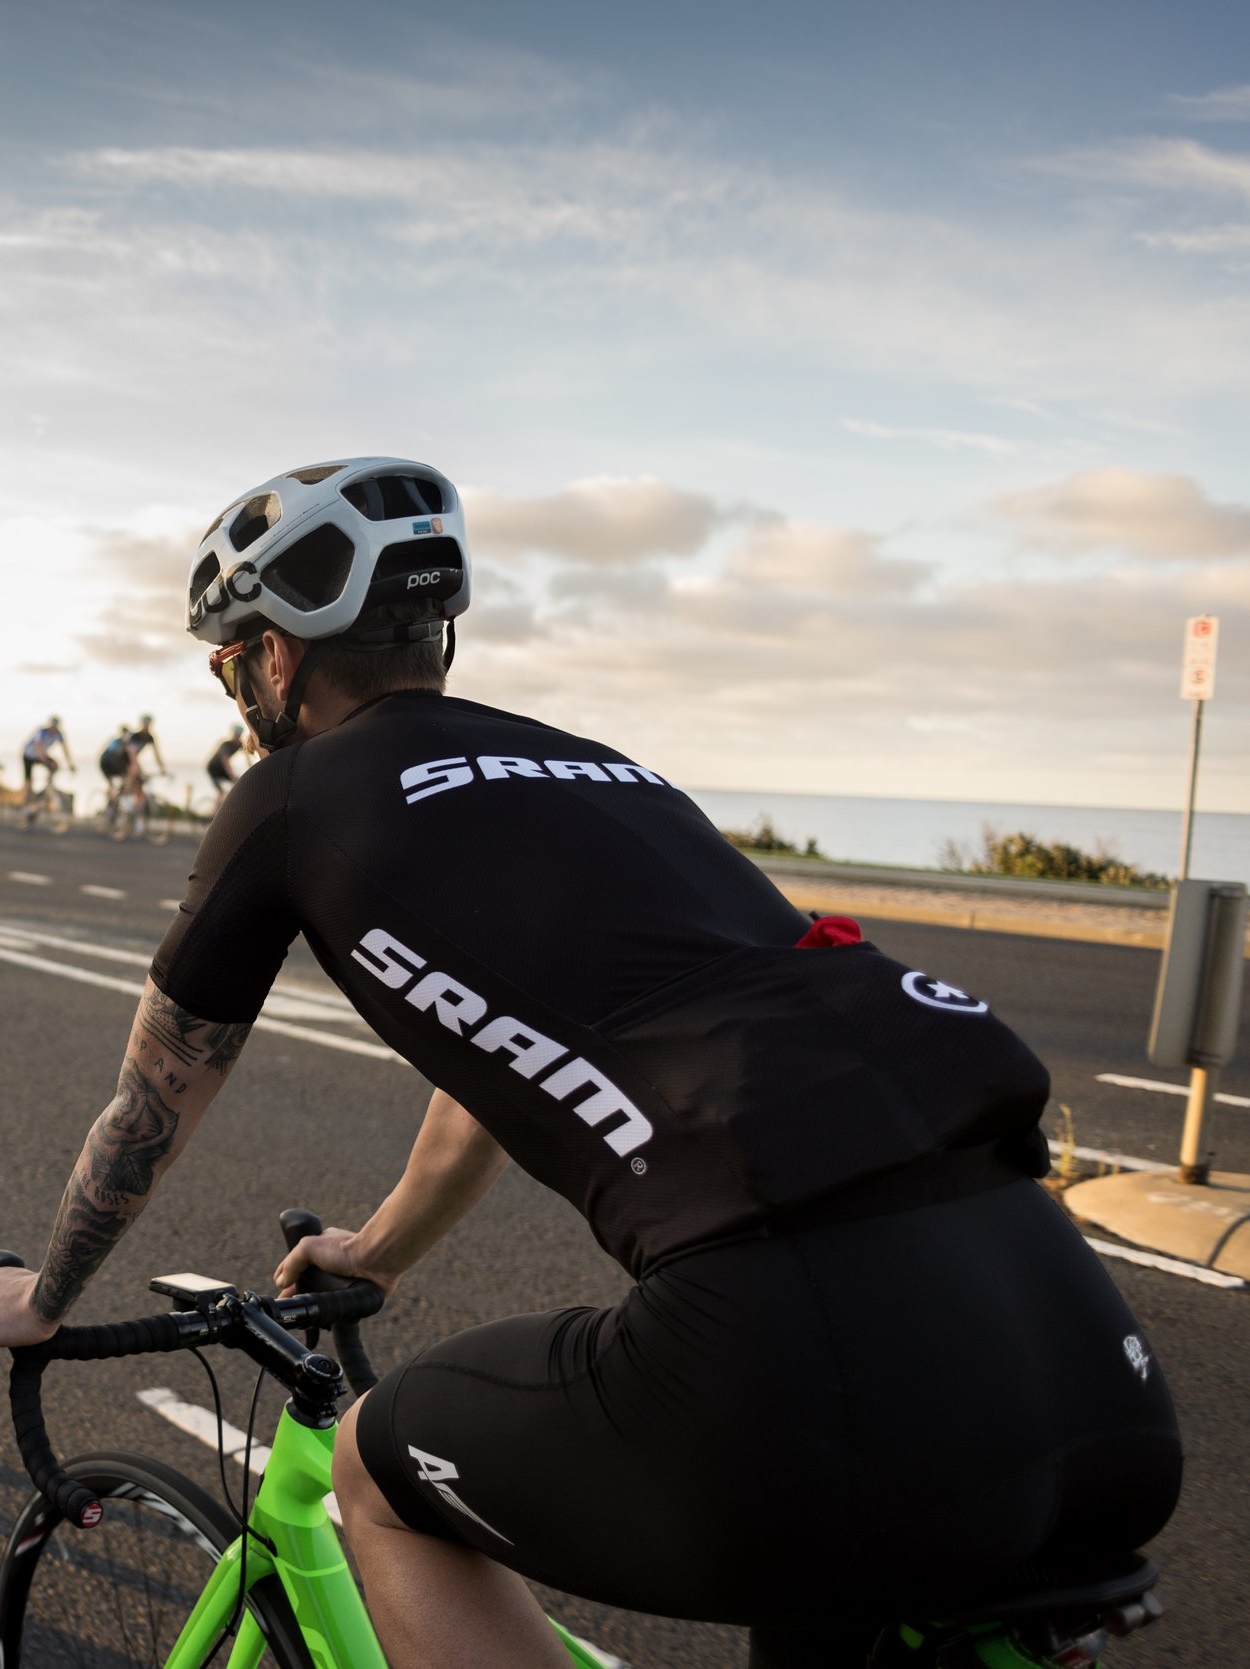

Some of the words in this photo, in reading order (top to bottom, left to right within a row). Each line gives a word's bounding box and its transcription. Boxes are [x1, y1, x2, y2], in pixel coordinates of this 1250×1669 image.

[407, 571, 441, 590] POC
[400, 755, 680, 805] SRAM
[350, 928, 653, 1158] SRAM
[154, 1057, 188, 1094] AND
[94, 1186, 130, 1206] ROSES
